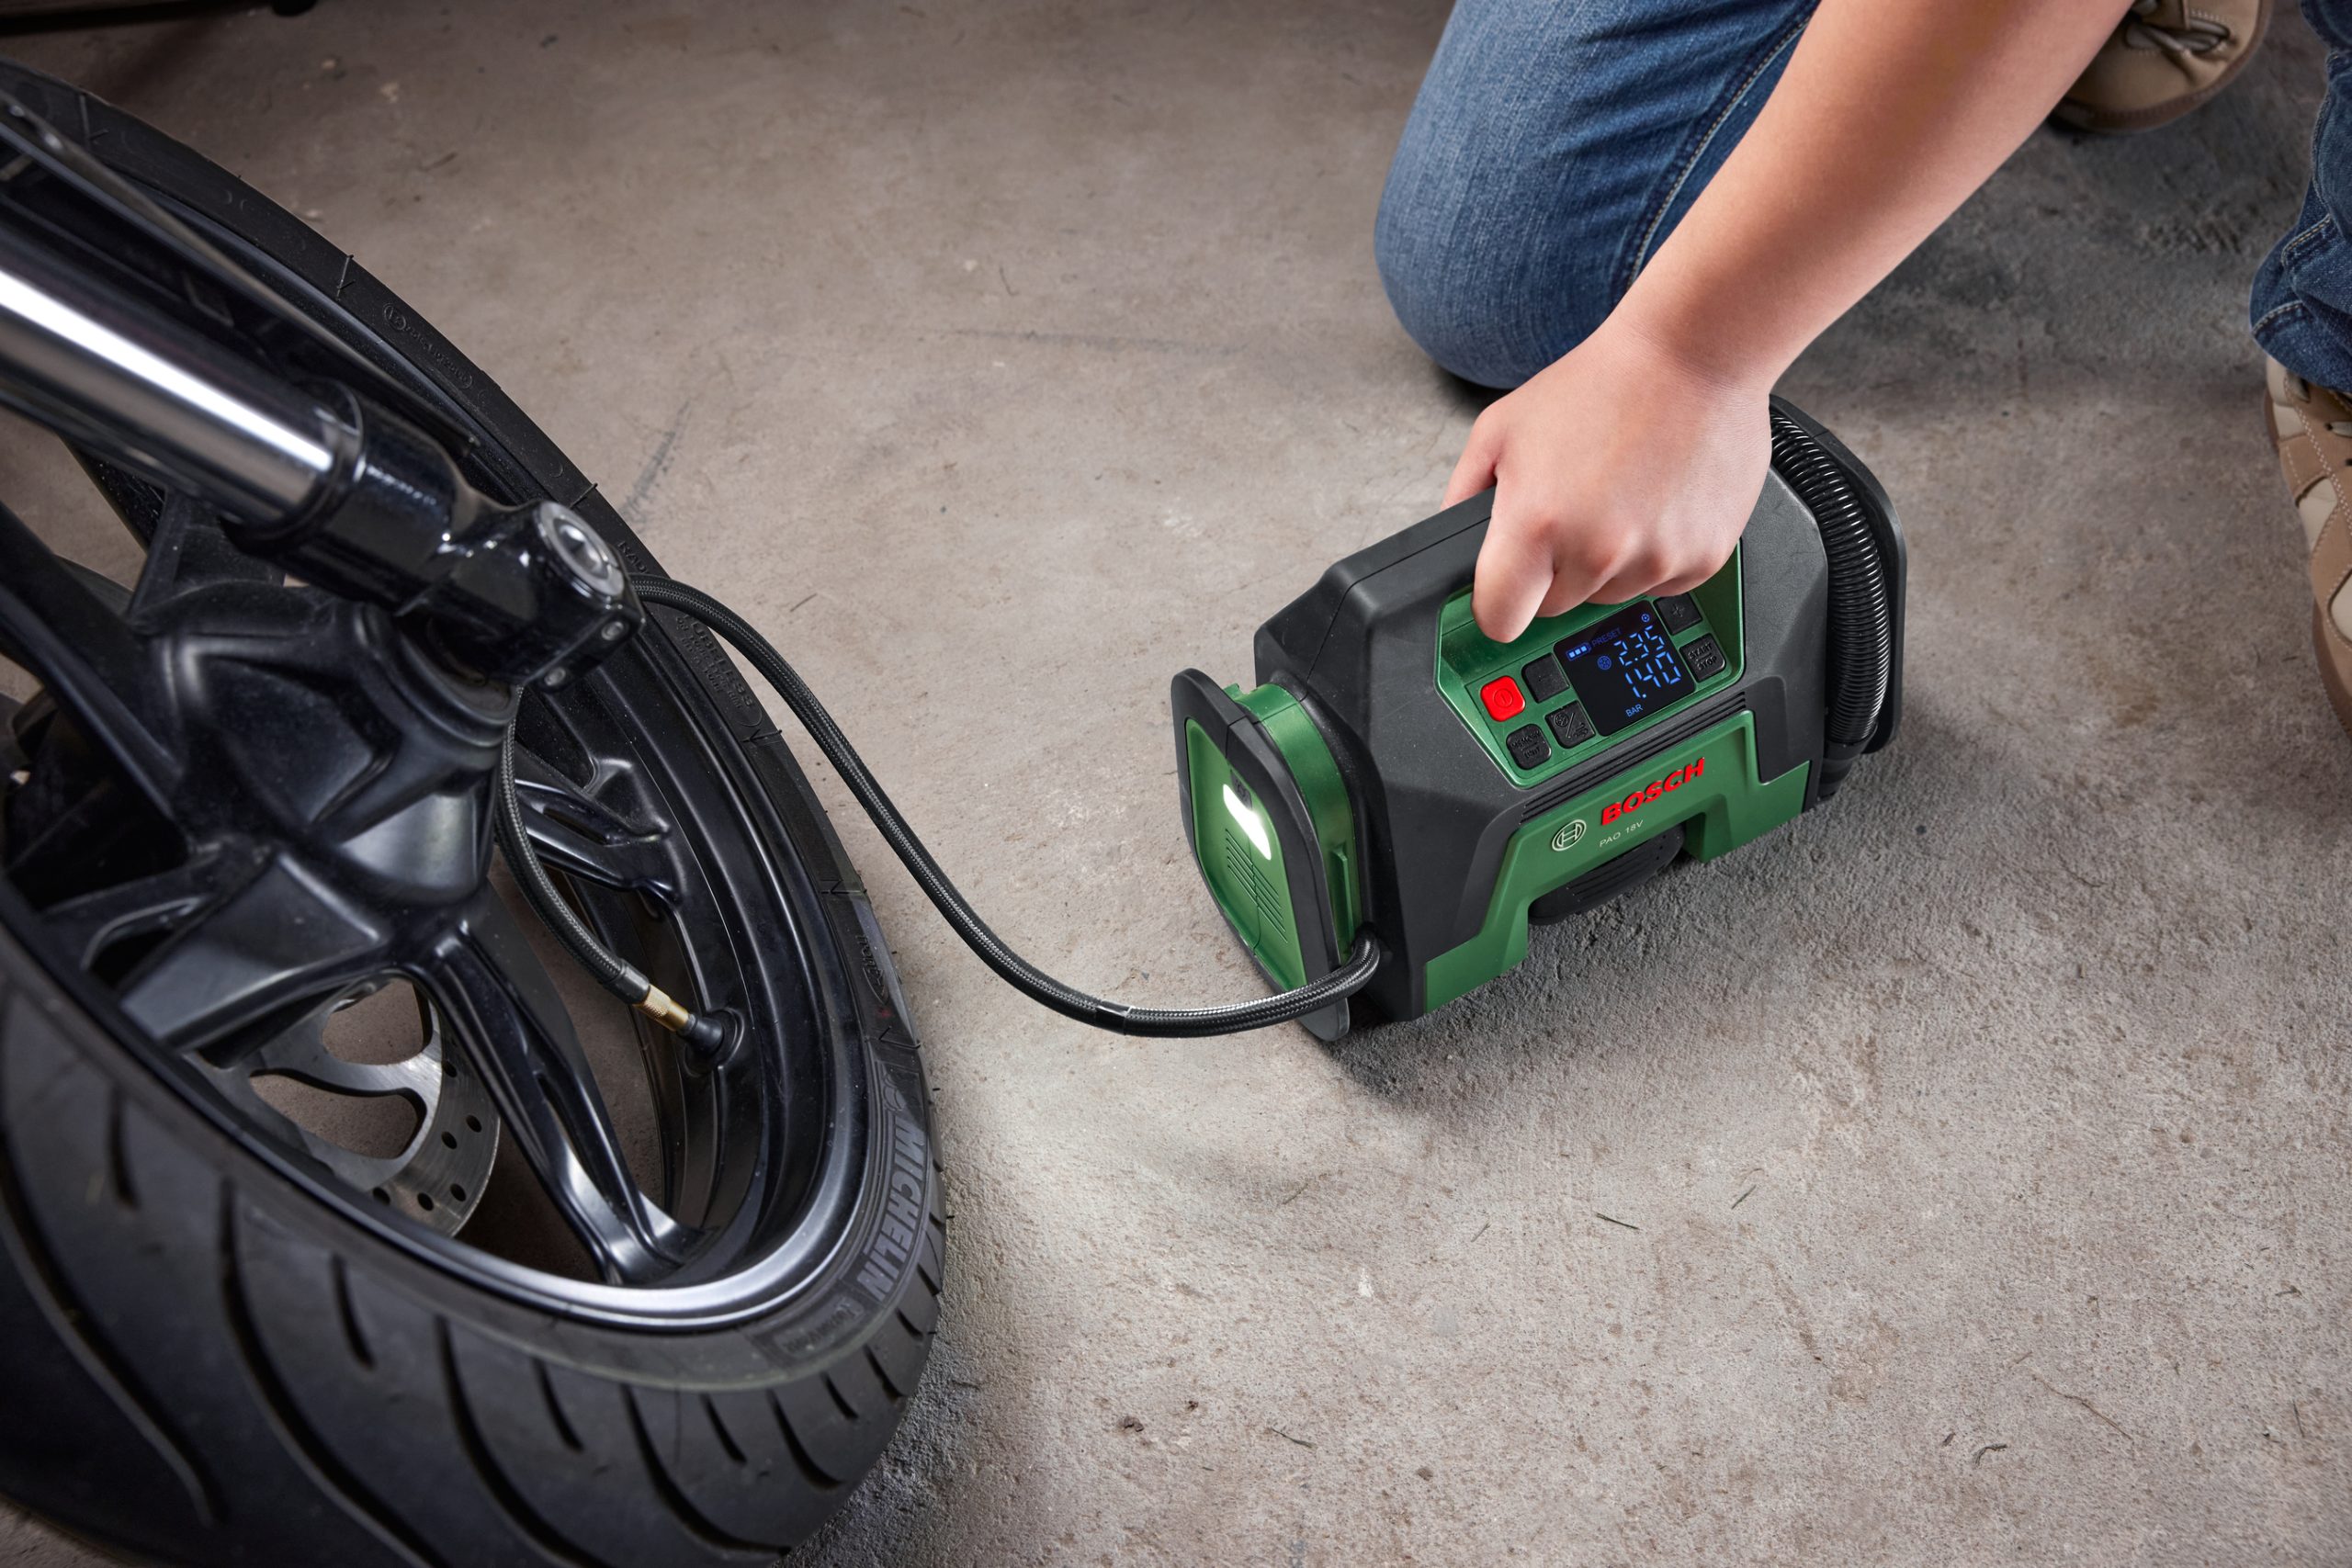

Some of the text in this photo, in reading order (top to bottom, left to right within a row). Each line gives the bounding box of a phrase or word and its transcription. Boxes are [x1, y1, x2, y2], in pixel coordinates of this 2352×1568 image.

[1591, 627, 1622, 647] PRESET
[1614, 626, 1665, 666] 2.35
[1625, 651, 1681, 698] 1.40
[1626, 704, 1643, 716] BAR
[1601, 758, 1705, 825] BOSCH
[1626, 819, 1643, 833] 18V
[857, 1116, 927, 1302] MICHELIN
